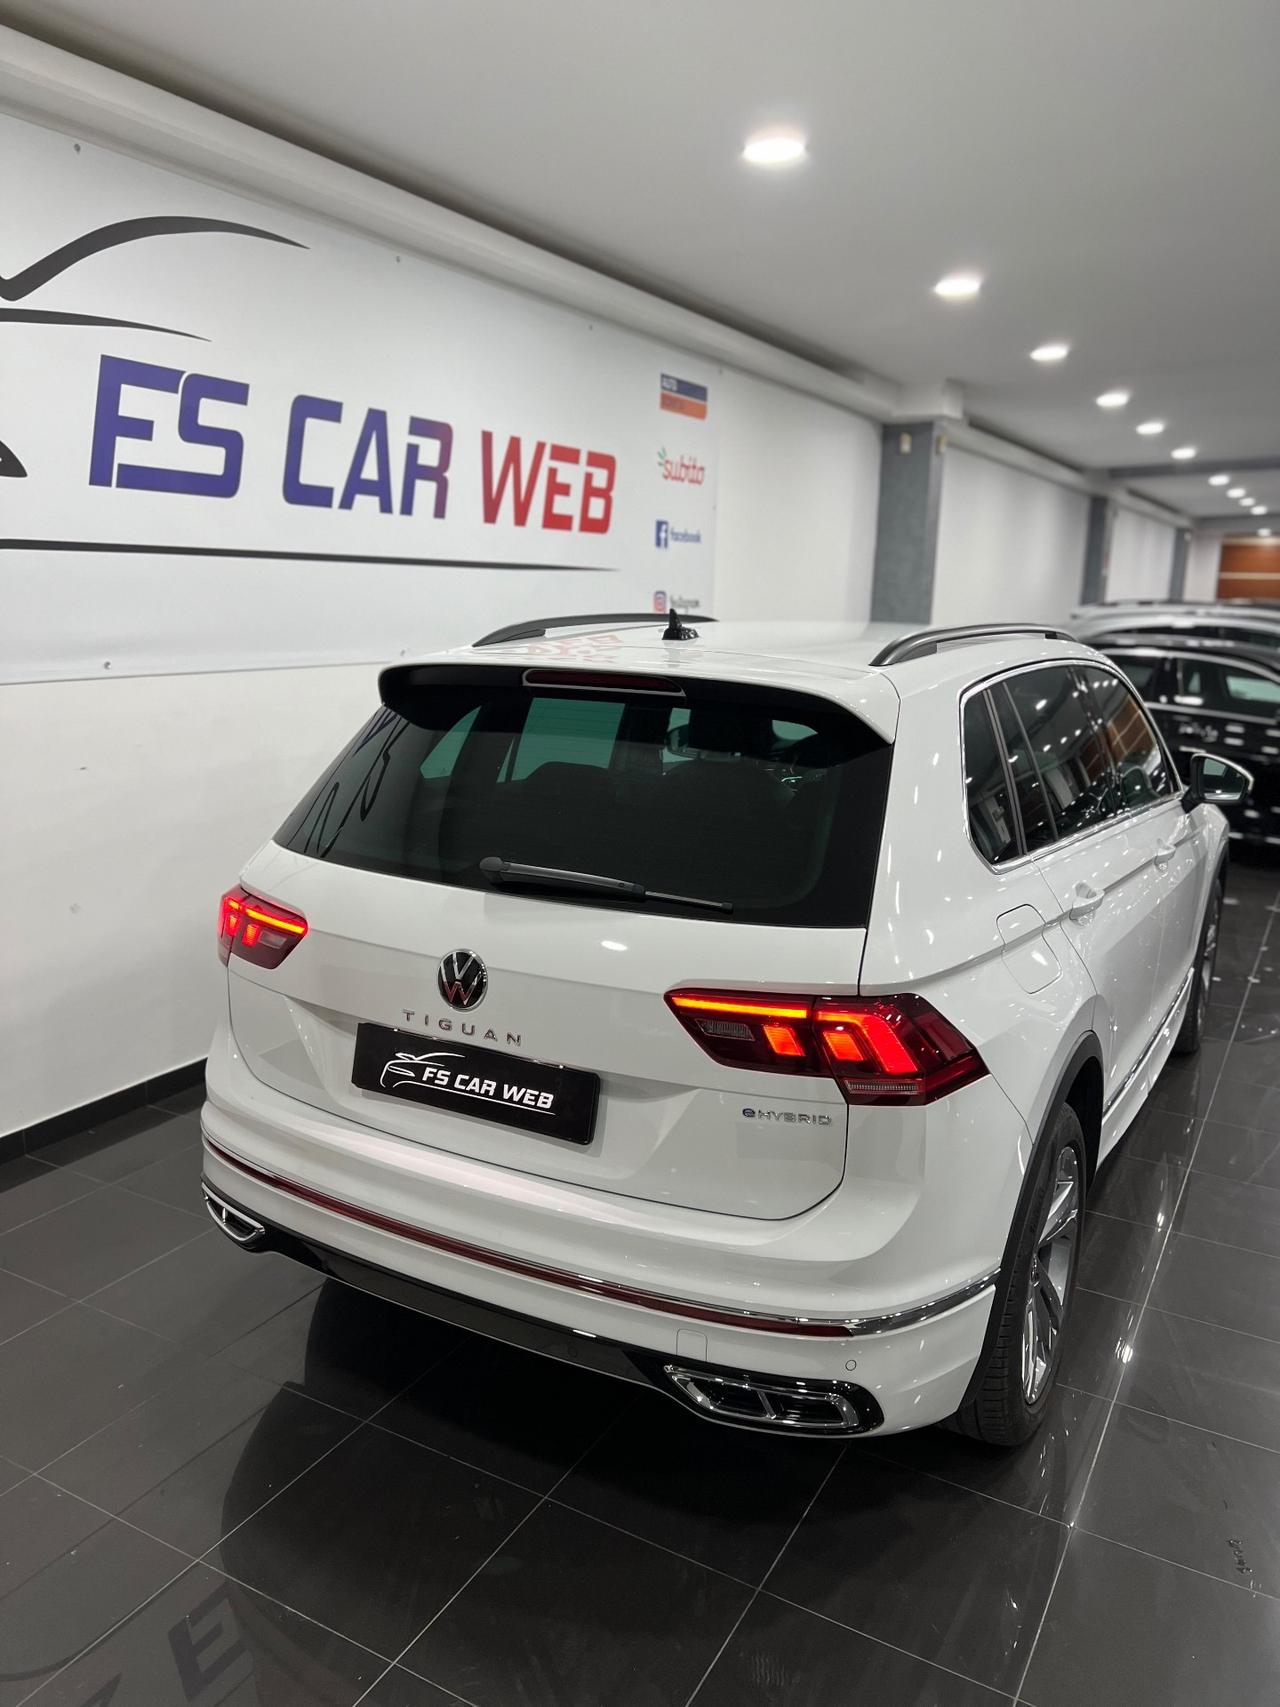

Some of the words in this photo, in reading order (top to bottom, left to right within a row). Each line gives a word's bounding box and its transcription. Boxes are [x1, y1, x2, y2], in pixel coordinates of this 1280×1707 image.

[89, 354, 250, 499] FS
[281, 393, 454, 519] CAR
[480, 430, 618, 534] WEB
[662, 453, 706, 486] subito
[402, 1008, 523, 1047] TIGUAN
[422, 1067, 450, 1087] FS
[453, 1073, 498, 1098] CAR
[502, 1084, 555, 1110] WEB
